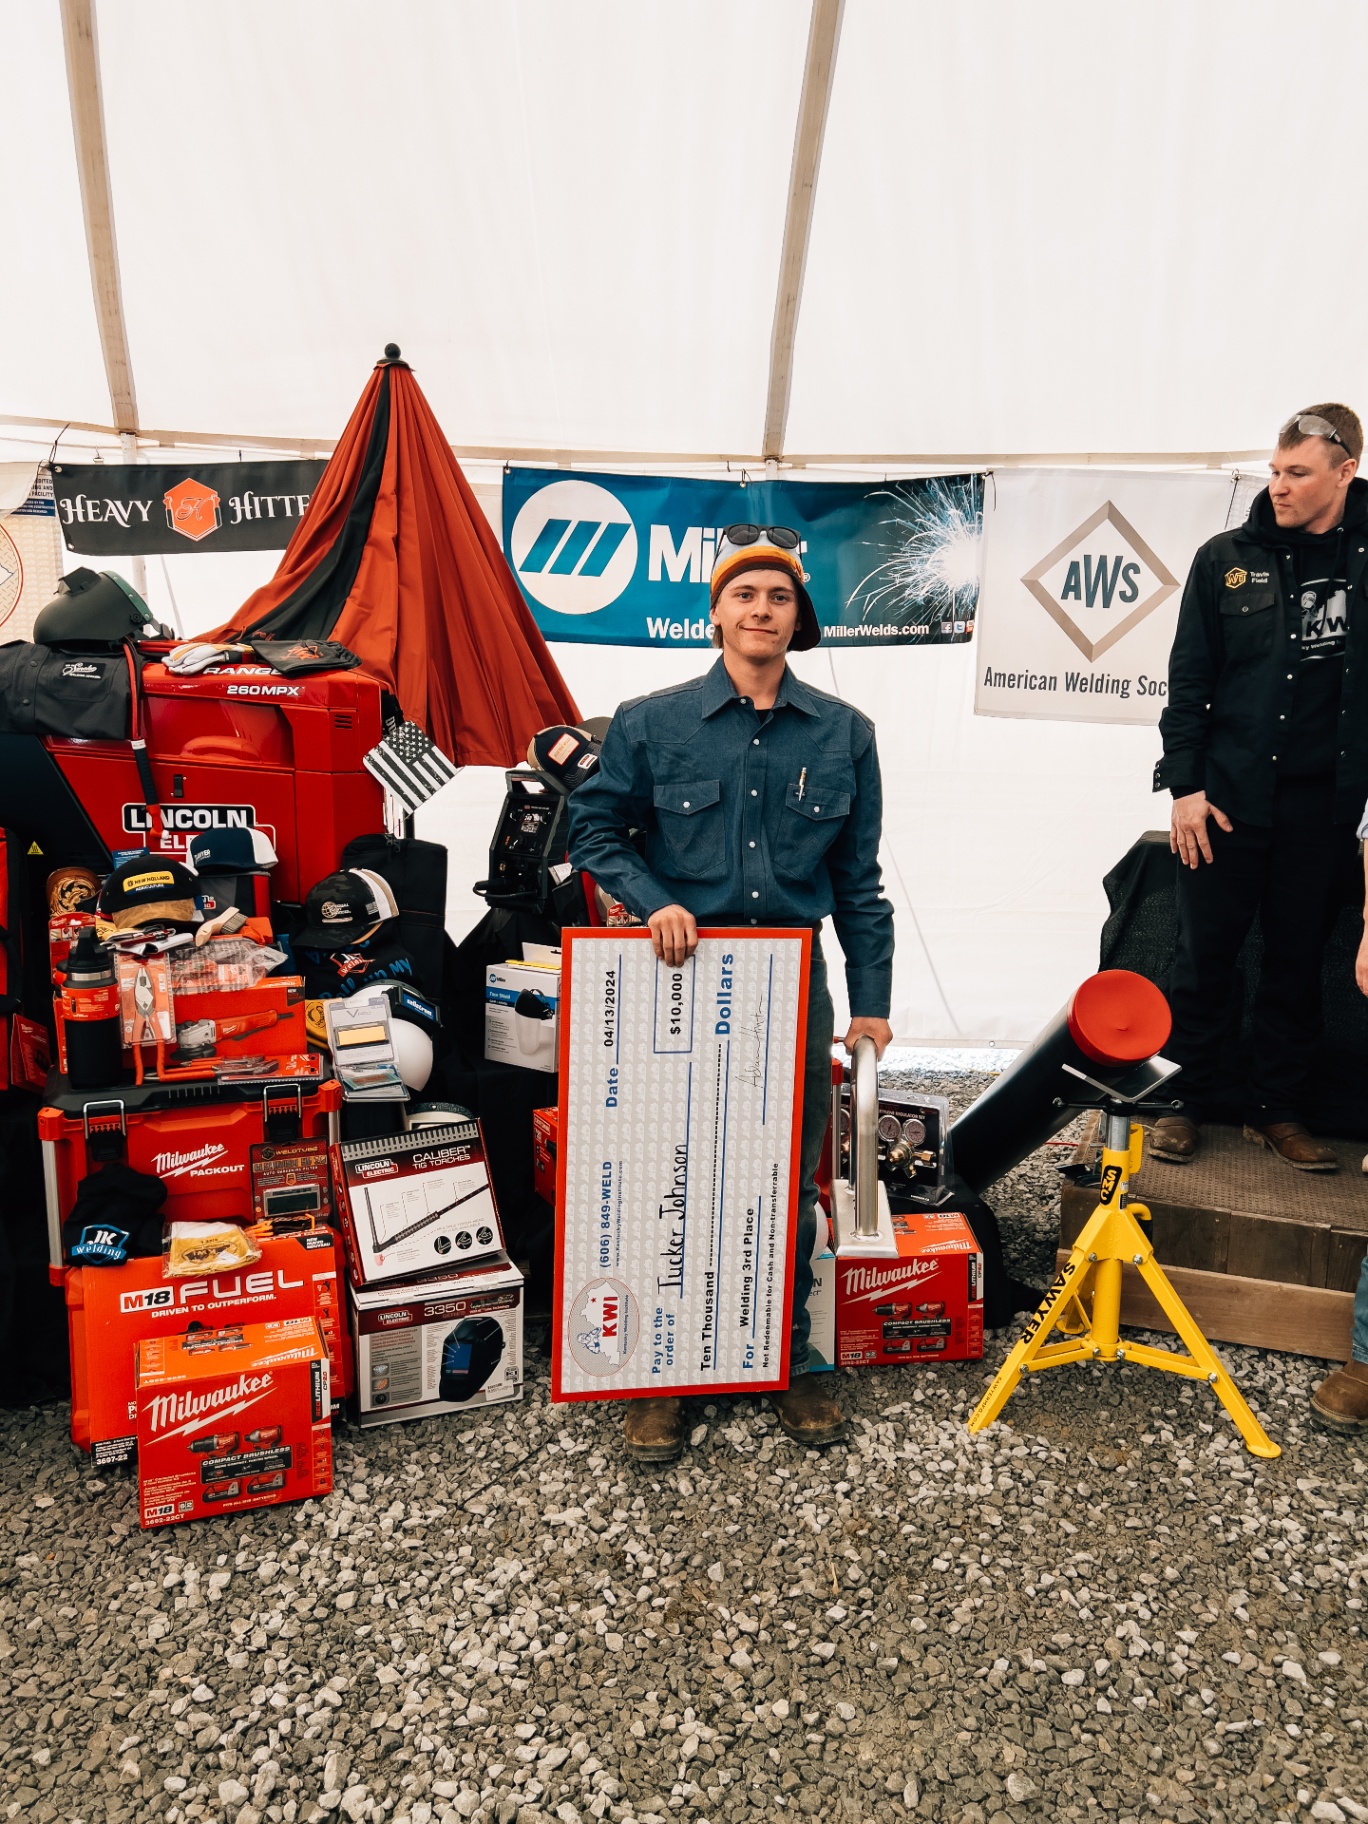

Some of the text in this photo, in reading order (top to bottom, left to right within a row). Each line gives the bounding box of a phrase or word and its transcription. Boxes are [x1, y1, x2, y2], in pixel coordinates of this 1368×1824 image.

[60, 491, 310, 528] HEAVY HITTE
[1061, 554, 1141, 609] AWS
[646, 617, 714, 640] Welde
[823, 623, 930, 639] MillerWelds.com
[1305, 616, 1347, 638] KW
[203, 667, 283, 675] RANGE
[984, 666, 1058, 692] American
[1065, 671, 1131, 699] Welding
[226, 685, 300, 696] 260MPX
[130, 808, 247, 828] LINCOLN
[604, 970, 616, 1047] 04/13/2024
[670, 973, 684, 1034] $10,000
[714, 953, 734, 1034] Dollars
[606, 1068, 618, 1108] Date
[151, 1143, 226, 1173] Milwaukee
[275, 1146, 318, 1155] WELDTUBE
[412, 1147, 466, 1163] CALIBER
[430, 1154, 470, 1166] TORCHES
[190, 1164, 245, 1177] PACKOUT
[358, 1160, 390, 1172] LINCOLN
[366, 1168, 394, 1177] ELECTRIC
[1100, 1170, 1117, 1200] SMC
[599, 1162, 613, 1268] (606) 849-WELD
[768, 1164, 778, 1240] Non-transferrable
[658, 1144, 688, 1294] Tucker Johnson
[921, 1241, 972, 1253] Milwaukee
[740, 1208, 754, 1328] Welding 3rd Place
[839, 1259, 938, 1296] Milwaukee
[124, 1273, 304, 1311] M18 FUEL
[1020, 1262, 1076, 1344] SAWYER
[152, 1306, 188, 1318] DRIVEN
[192, 1304, 204, 1312] TO
[380, 1311, 407, 1320] LINCOLN
[424, 1302, 466, 1317] 3350
[602, 1296, 618, 1338] KWI
[700, 1271, 714, 1372] Ten Thousand
[664, 1314, 675, 1366] order of
[764, 1300, 773, 1350] Redeemable
[652, 1307, 664, 1374] Pay to the
[251, 1347, 319, 1368] Milwaukee
[742, 1344, 755, 1369] For
[142, 1373, 274, 1432] Milwaukee
[970, 1377, 1002, 1428] SAWYERMFG.COM
[202, 1446, 290, 1466] COMPACT BRUSHLESS
[146, 1505, 173, 1517] M18
